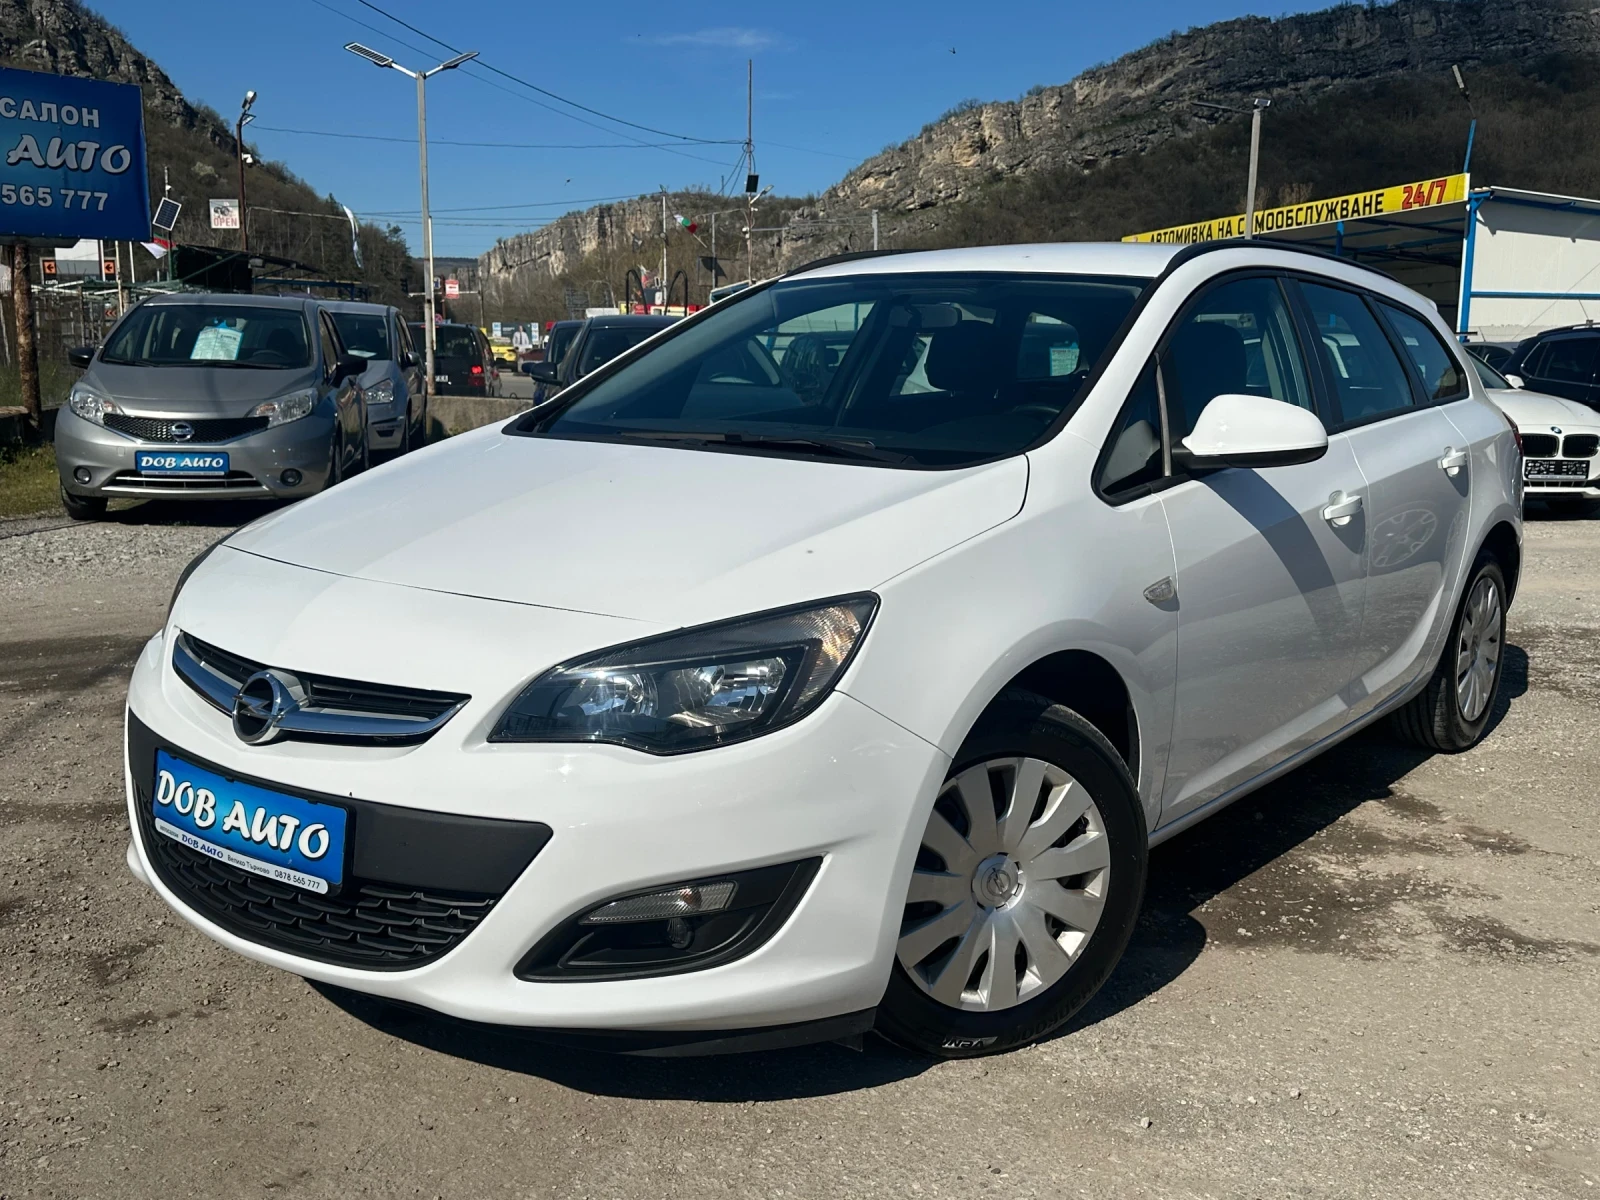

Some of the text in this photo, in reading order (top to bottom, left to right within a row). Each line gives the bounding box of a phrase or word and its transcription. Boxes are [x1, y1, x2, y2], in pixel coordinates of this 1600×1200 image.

[0, 97, 100, 128] САЛОН
[6, 134, 131, 174] AUTO
[1, 183, 108, 211] 565 777
[1218, 220, 1233, 239] НА
[1237, 192, 1385, 235] СМООБСЛУЖВАНЕ
[1402, 178, 1447, 210] 24/7
[213, 217, 237, 227] OPEN
[141, 456, 224, 468] DOB AUTO
[157, 769, 330, 860] DOB AUTO
[181, 833, 199, 849] DOB
[200, 844, 224, 859] AUTO
[274, 869, 292, 881] 0878
[293, 875, 306, 886] 565
[307, 879, 321, 890] 777
